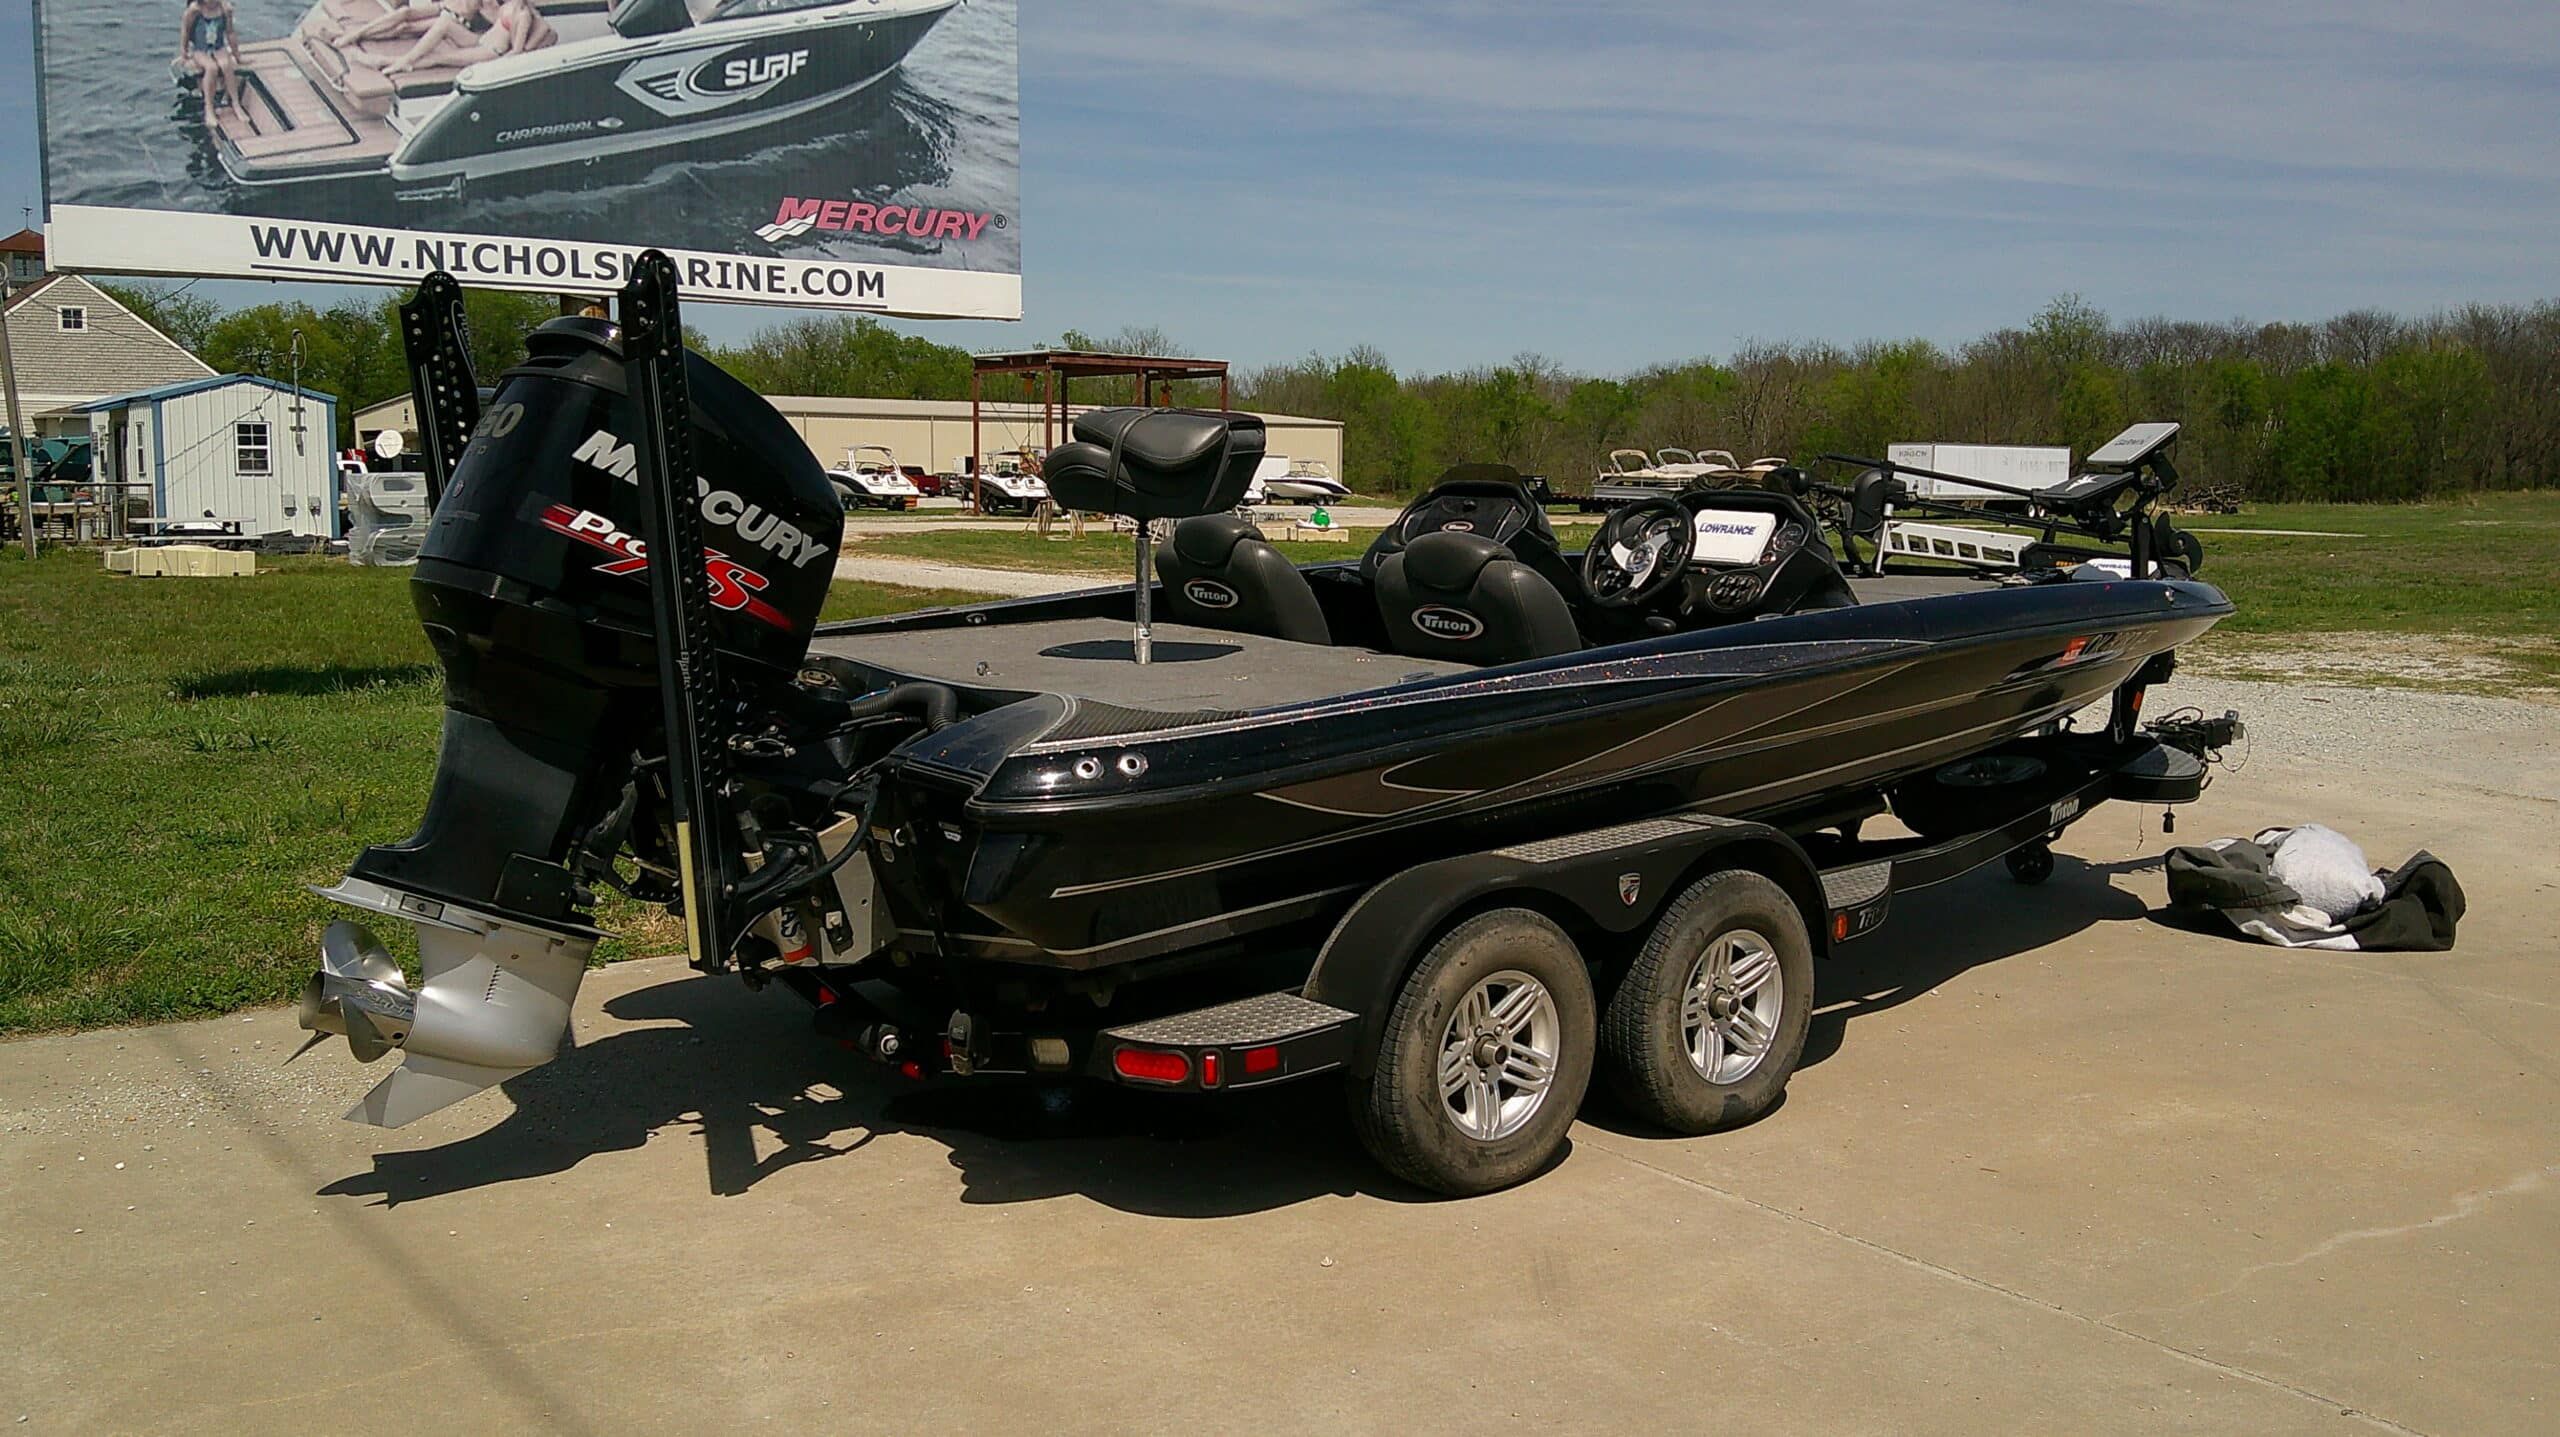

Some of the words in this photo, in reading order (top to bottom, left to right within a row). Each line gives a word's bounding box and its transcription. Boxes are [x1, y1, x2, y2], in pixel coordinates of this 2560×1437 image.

[724, 50, 809, 87] SURF
[496, 120, 593, 143] CHAPARRAL
[250, 224, 885, 299] WWW.NICHOLSRINE.COM
[571, 429, 829, 569] MCURY
[1699, 523, 1757, 536] LOWRANCE
[1422, 614, 1470, 632] Triton
